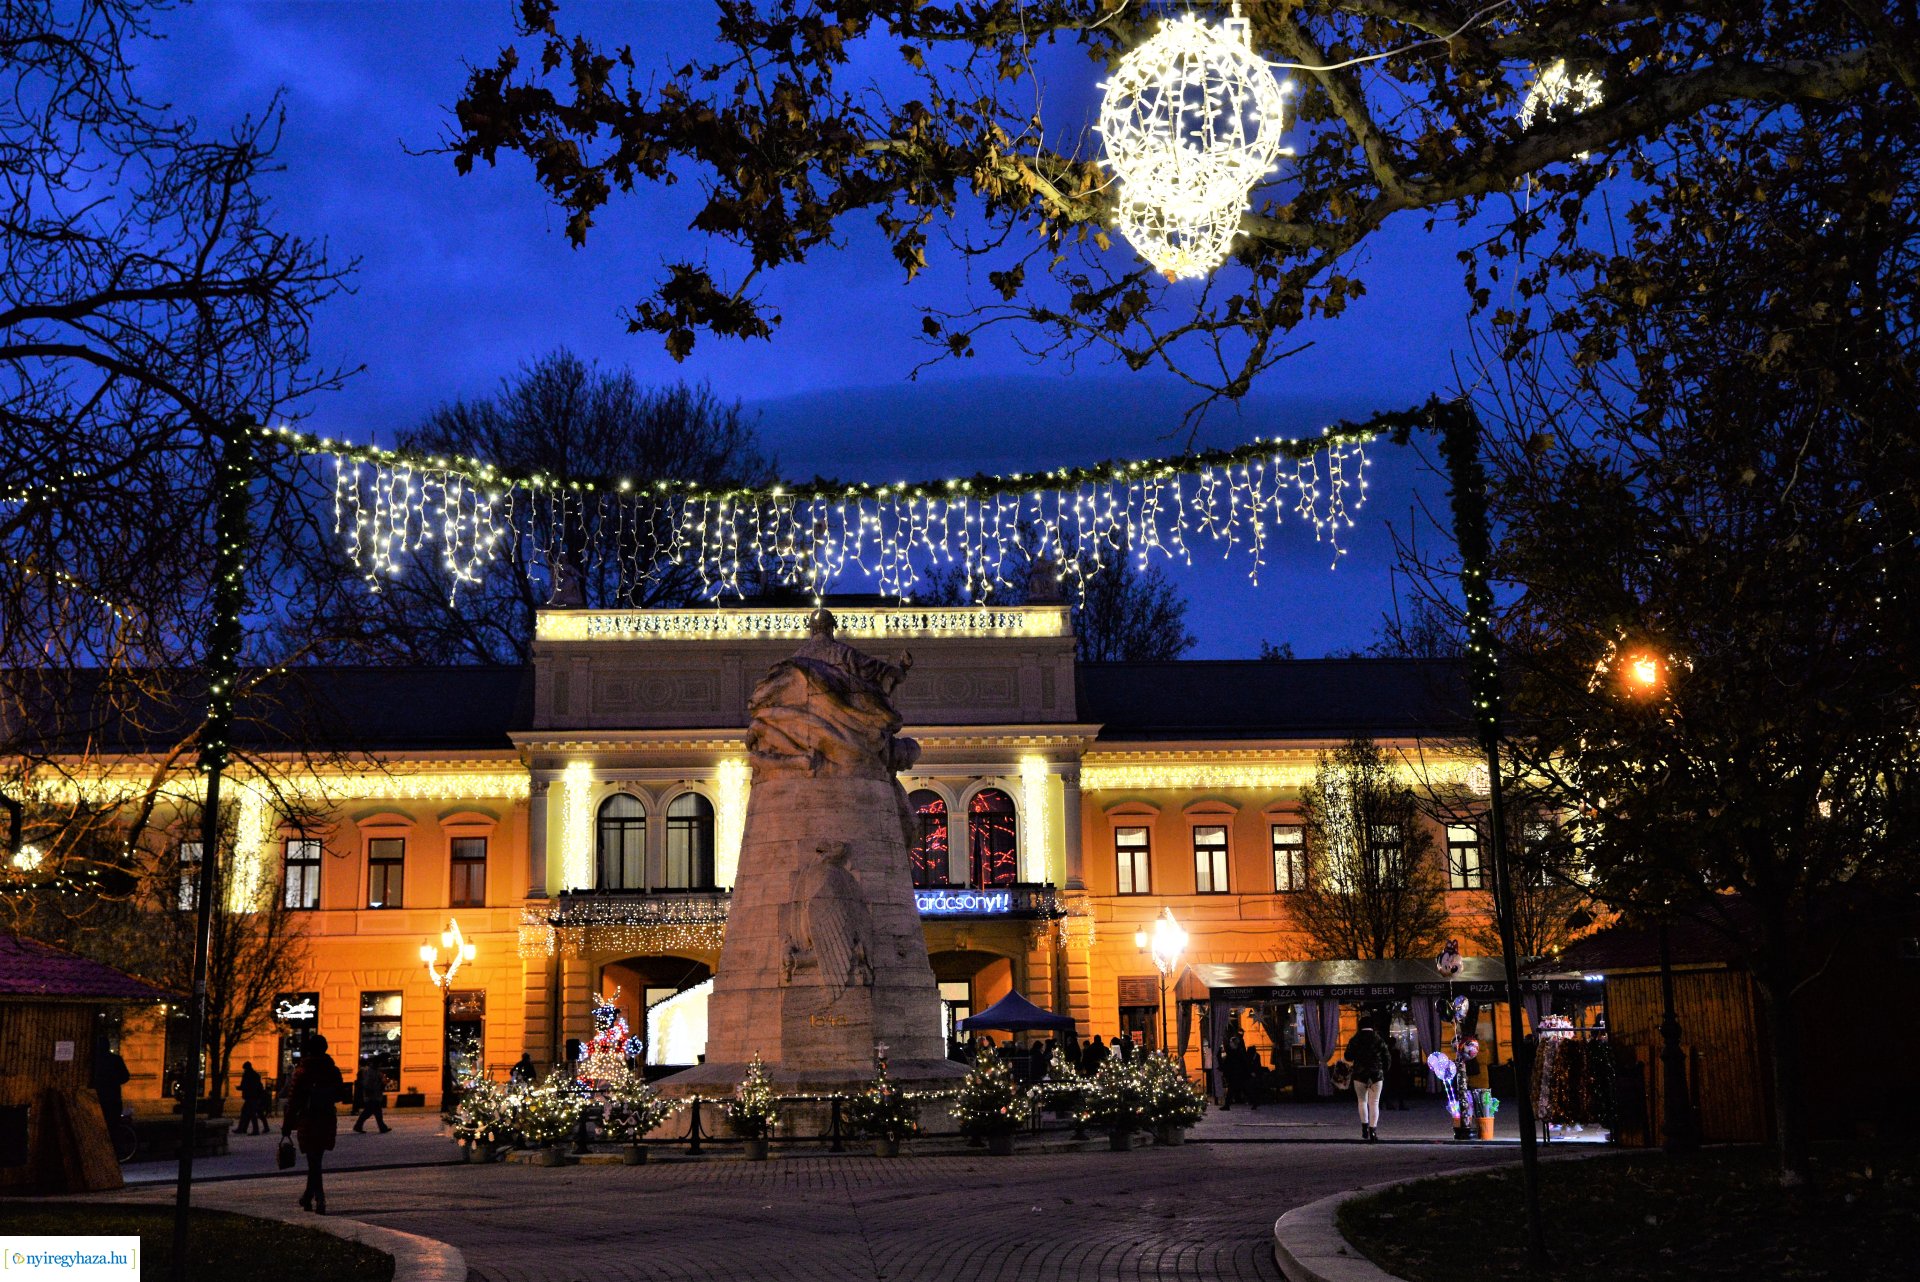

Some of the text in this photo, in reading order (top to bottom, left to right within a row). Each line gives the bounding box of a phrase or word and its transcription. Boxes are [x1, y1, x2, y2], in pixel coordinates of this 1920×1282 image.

[914, 891, 1009, 912] arácsonyt!
[1272, 987, 1395, 997] PIZZA WINE COFFEE BEER
[1470, 984, 1495, 992] PIZZA
[810, 1014, 847, 1027] 1848
